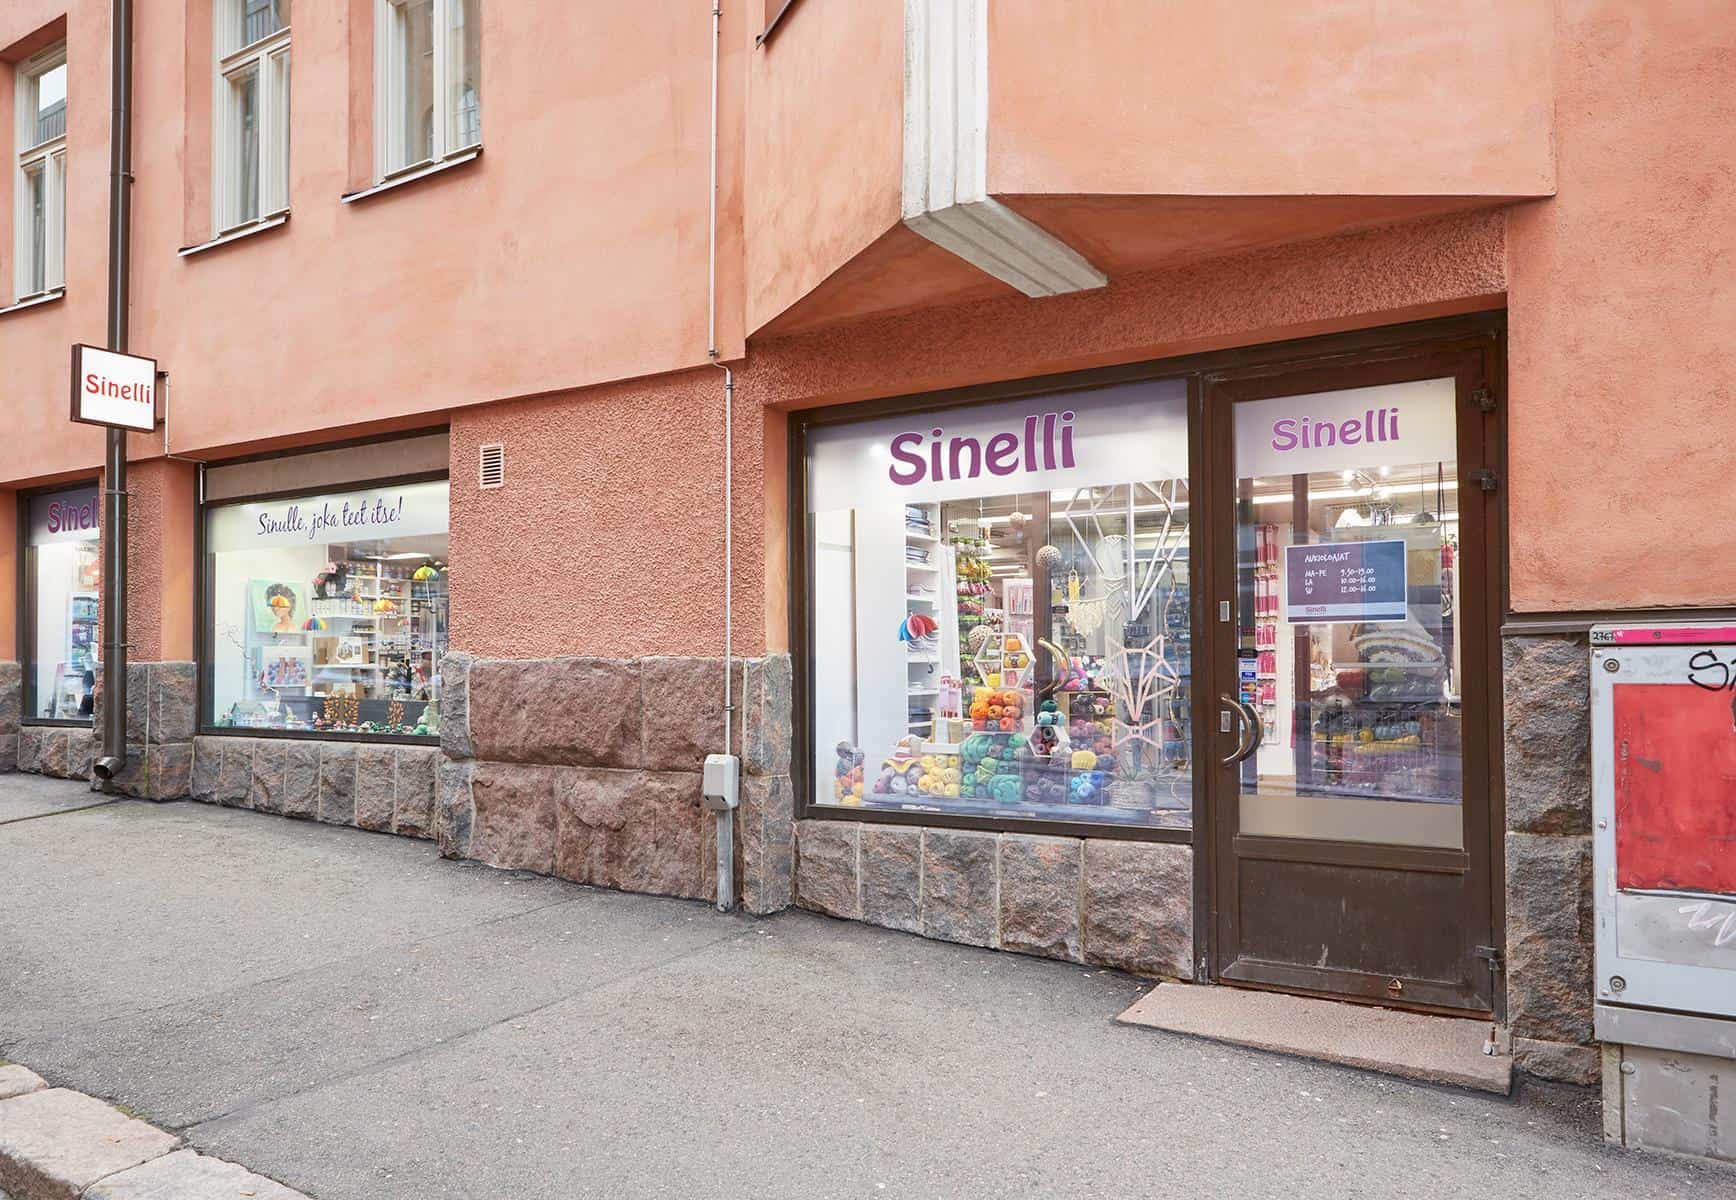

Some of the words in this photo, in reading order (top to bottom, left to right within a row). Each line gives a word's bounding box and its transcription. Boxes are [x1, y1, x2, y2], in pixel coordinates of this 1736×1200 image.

[86, 374, 150, 404] Sinelli
[889, 411, 1076, 486] Sinelli
[1271, 407, 1400, 451] Sinelli
[48, 496, 99, 533] Sinel
[257, 505, 308, 535] Sinulle,
[308, 503, 338, 539] joka
[342, 500, 367, 526] teet
[371, 496, 403, 524] itse!
